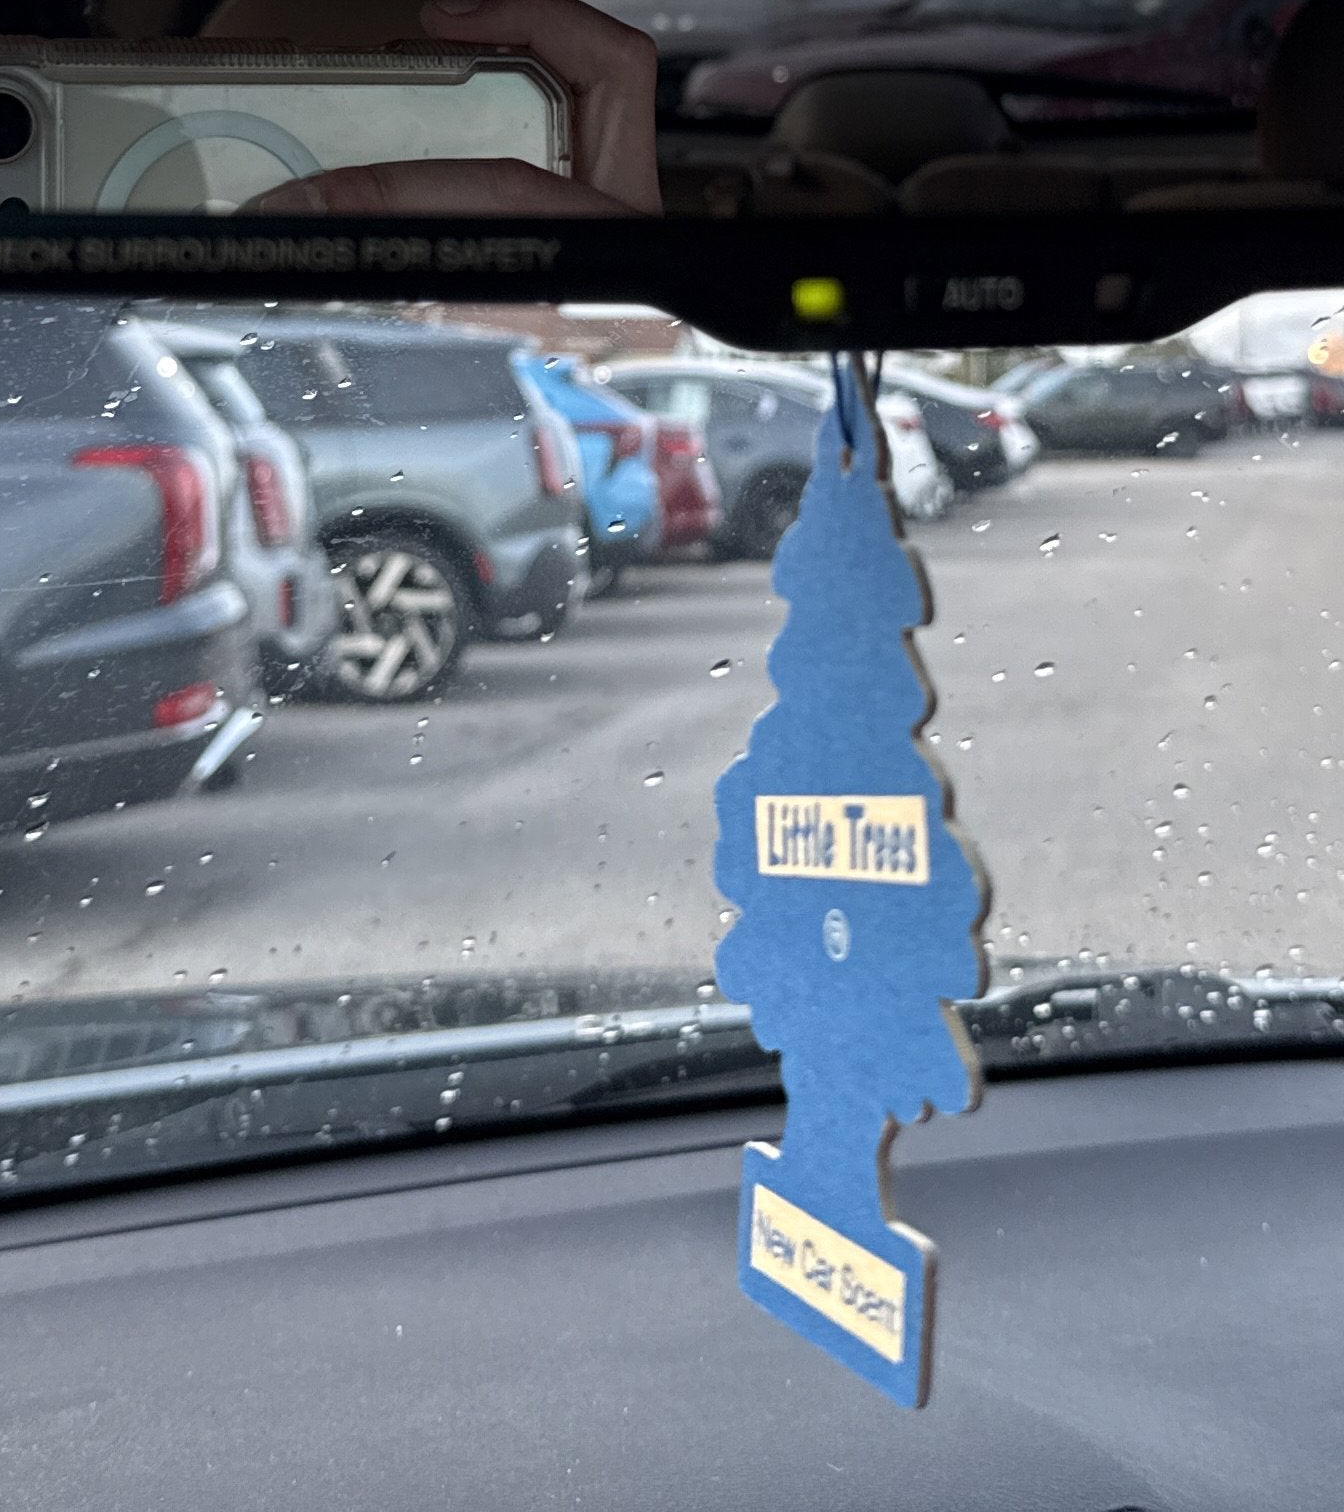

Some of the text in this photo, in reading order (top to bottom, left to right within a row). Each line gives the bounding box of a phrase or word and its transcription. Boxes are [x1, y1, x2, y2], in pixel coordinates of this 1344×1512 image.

[78, 238, 355, 272] SURROUNDINGS
[358, 238, 429, 271] FOR
[434, 237, 561, 271] SAFETY
[942, 275, 1025, 312] AUTO
[767, 802, 917, 875] Little Trees
[756, 1208, 901, 1336] New Car Scent
